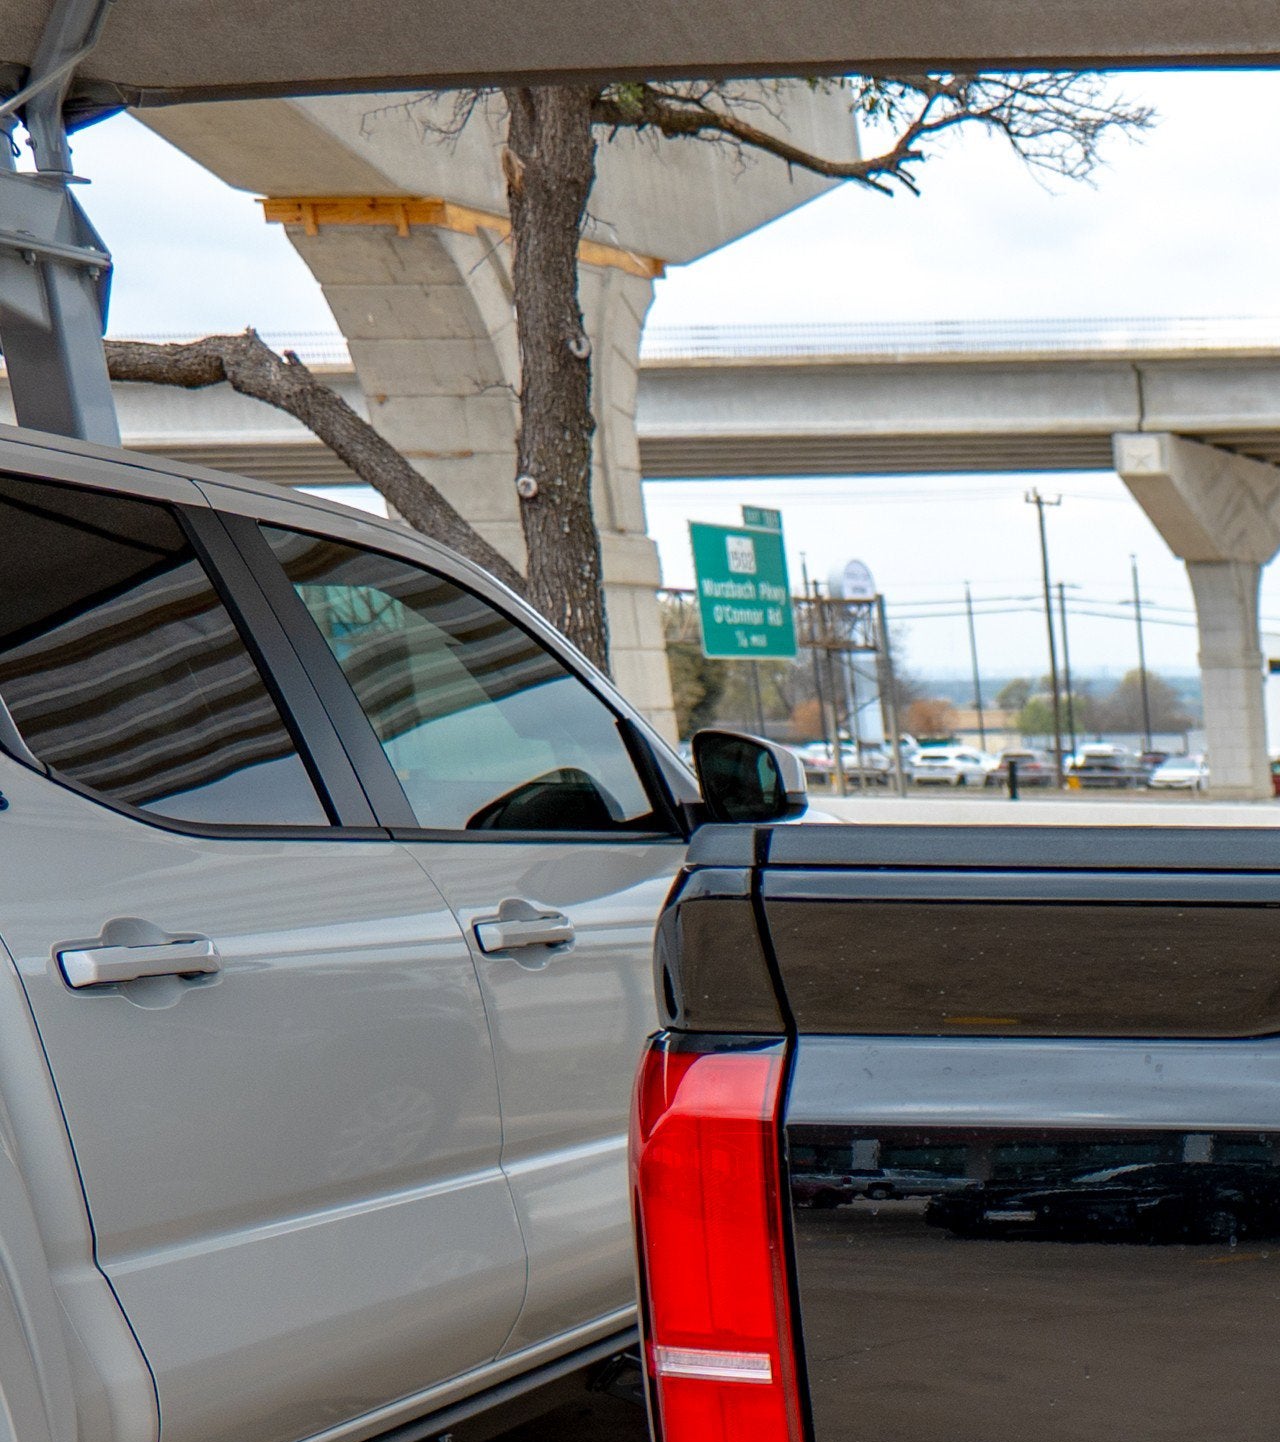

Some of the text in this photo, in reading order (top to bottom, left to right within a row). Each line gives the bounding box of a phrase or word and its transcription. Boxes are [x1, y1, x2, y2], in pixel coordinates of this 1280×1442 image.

[702, 578, 756, 600] Wurzbach
[713, 604, 783, 626] O'Connor Rd
